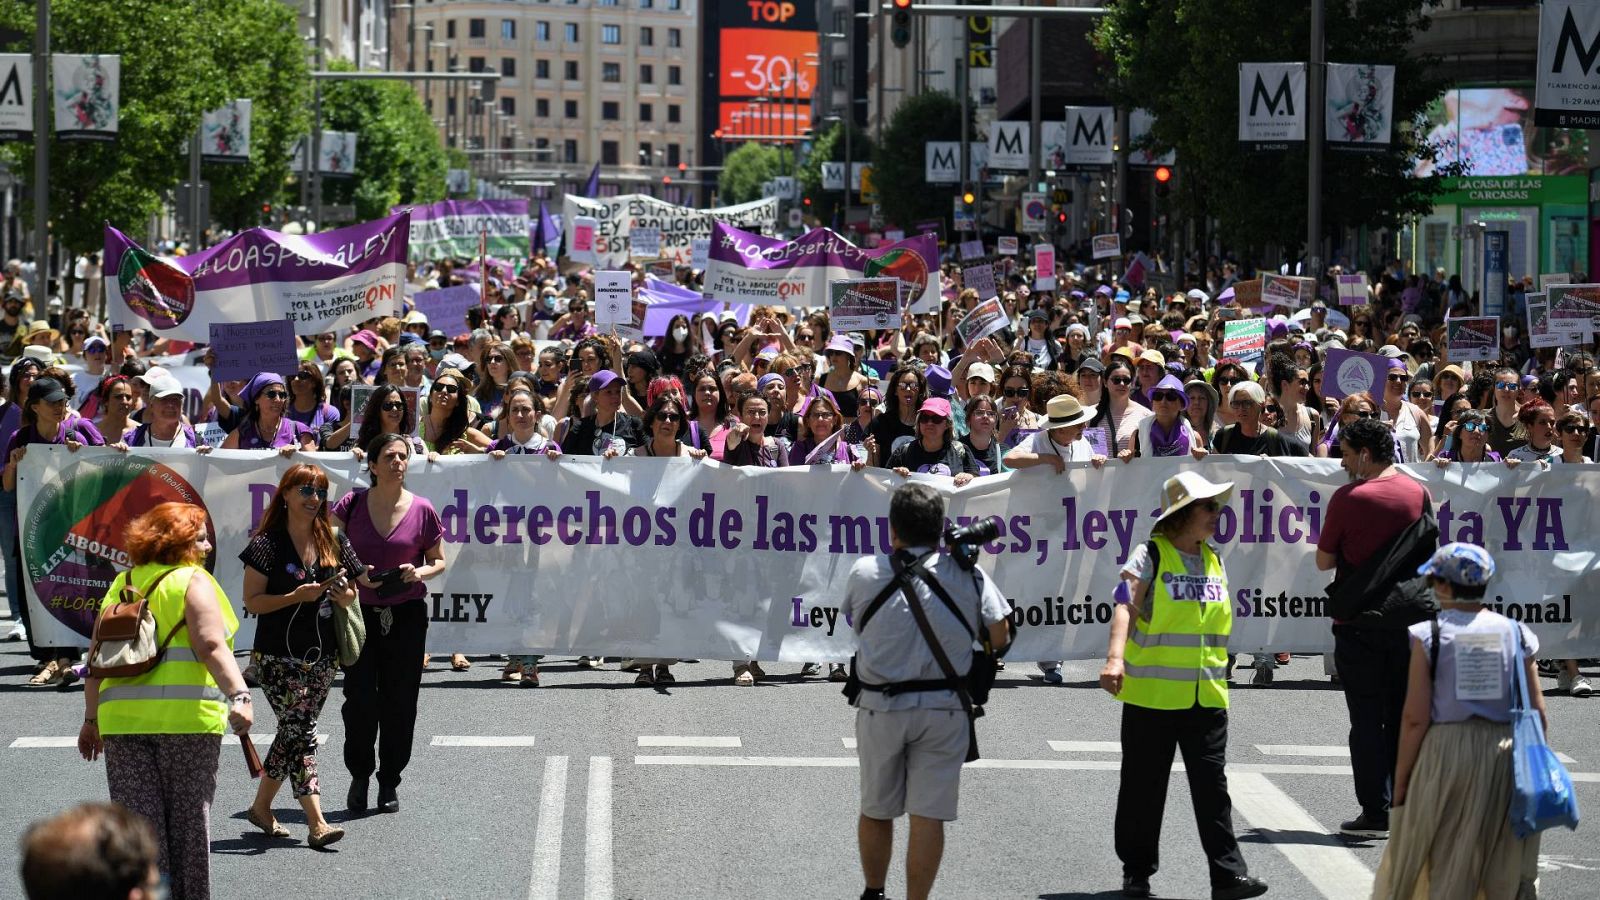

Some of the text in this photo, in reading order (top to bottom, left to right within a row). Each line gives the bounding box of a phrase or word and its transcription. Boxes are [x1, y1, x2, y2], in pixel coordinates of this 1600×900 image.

[747, 1, 796, 22] TOP
[730, 54, 809, 92] -30%
[1547, 82, 1589, 90] FLAMENCO
[1458, 180, 1542, 189] LA CASA DE LAS
[1469, 190, 1529, 199] CARCASAS
[714, 283, 724, 292] DE
[721, 277, 734, 285] POR
[845, 288, 892, 308] ABOLICIONISTA
[291, 301, 310, 311] POR
[313, 300, 327, 309] LA
[285, 312, 297, 321] DE
[301, 311, 314, 321] LA
[27, 501, 48, 550] Plataforma
[128, 461, 146, 471] por
[160, 471, 193, 504] Abolición
[442, 488, 678, 547] derechos
[688, 492, 743, 549] de
[751, 495, 818, 553] las
[1061, 497, 1139, 566] ley
[1497, 496, 1570, 551] YA
[41, 546, 68, 575] LEY
[49, 574, 107, 588] DEL SISTEMA
[791, 597, 840, 636] Ley
[1236, 587, 1332, 618] Sistem
